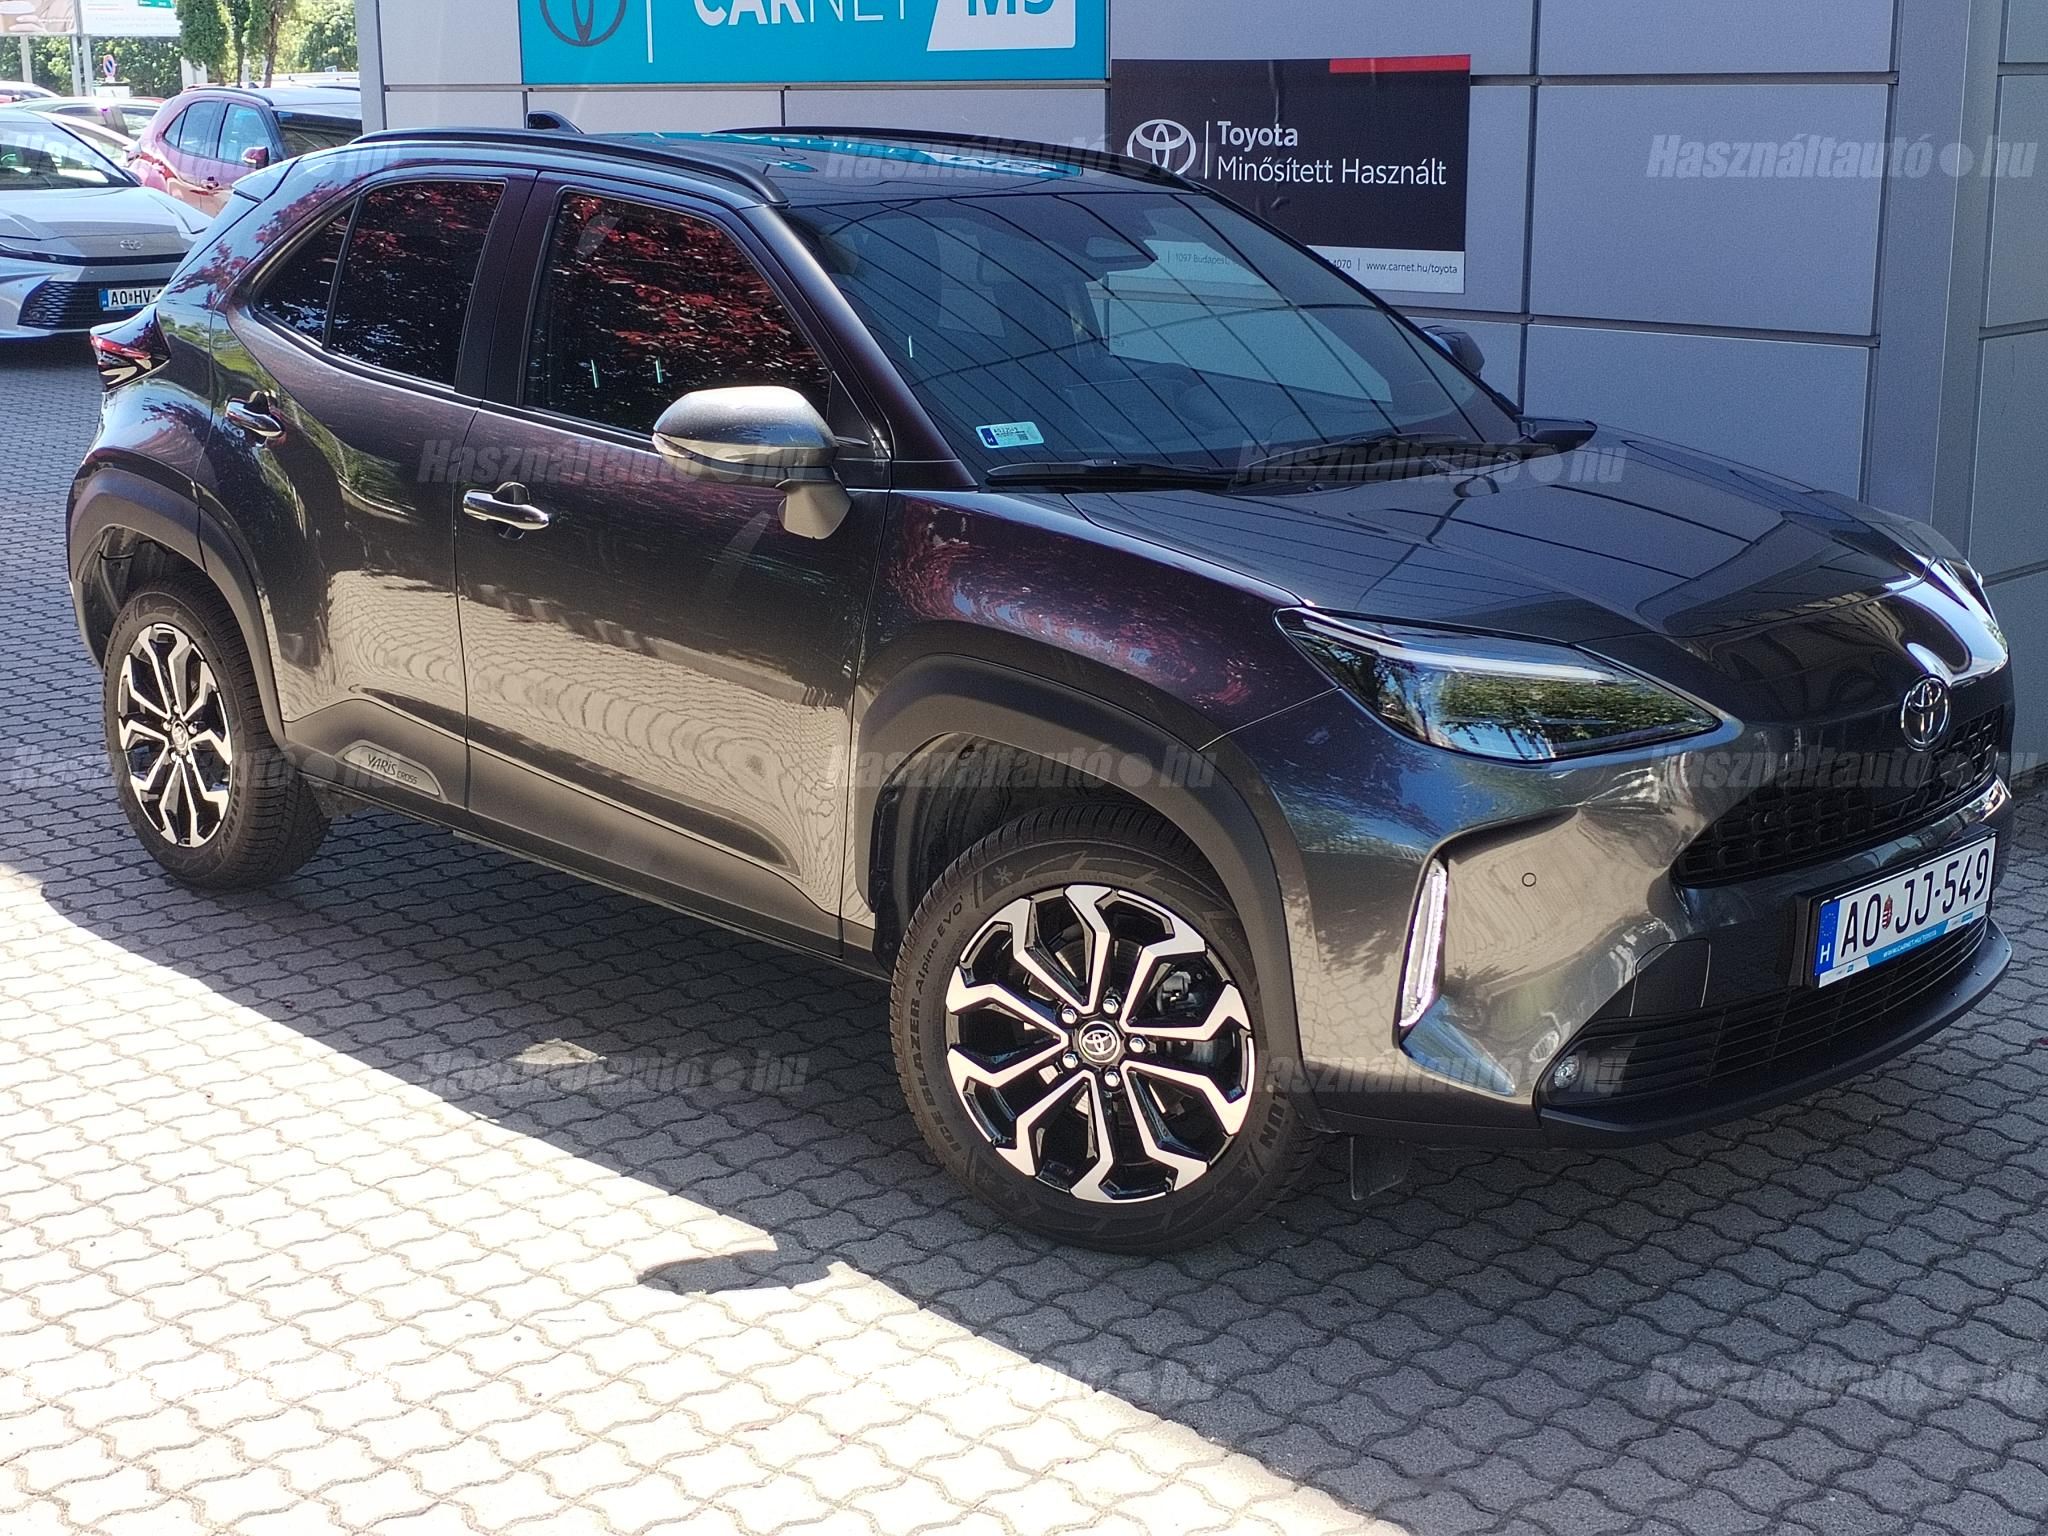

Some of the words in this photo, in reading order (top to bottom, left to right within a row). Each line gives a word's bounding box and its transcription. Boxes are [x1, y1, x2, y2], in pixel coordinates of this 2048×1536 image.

[1217, 120, 1298, 152] Toyota
[1217, 155, 1334, 183] Minősített
[1341, 157, 1447, 185] Használt
[1366, 261, 1458, 275] www.carnet.hu/toyota
[1841, 893, 1882, 958] AO
[1895, 848, 1989, 934] JJ-549
[915, 938, 939, 995] Alpine
[910, 998, 936, 1106] BLAZER
